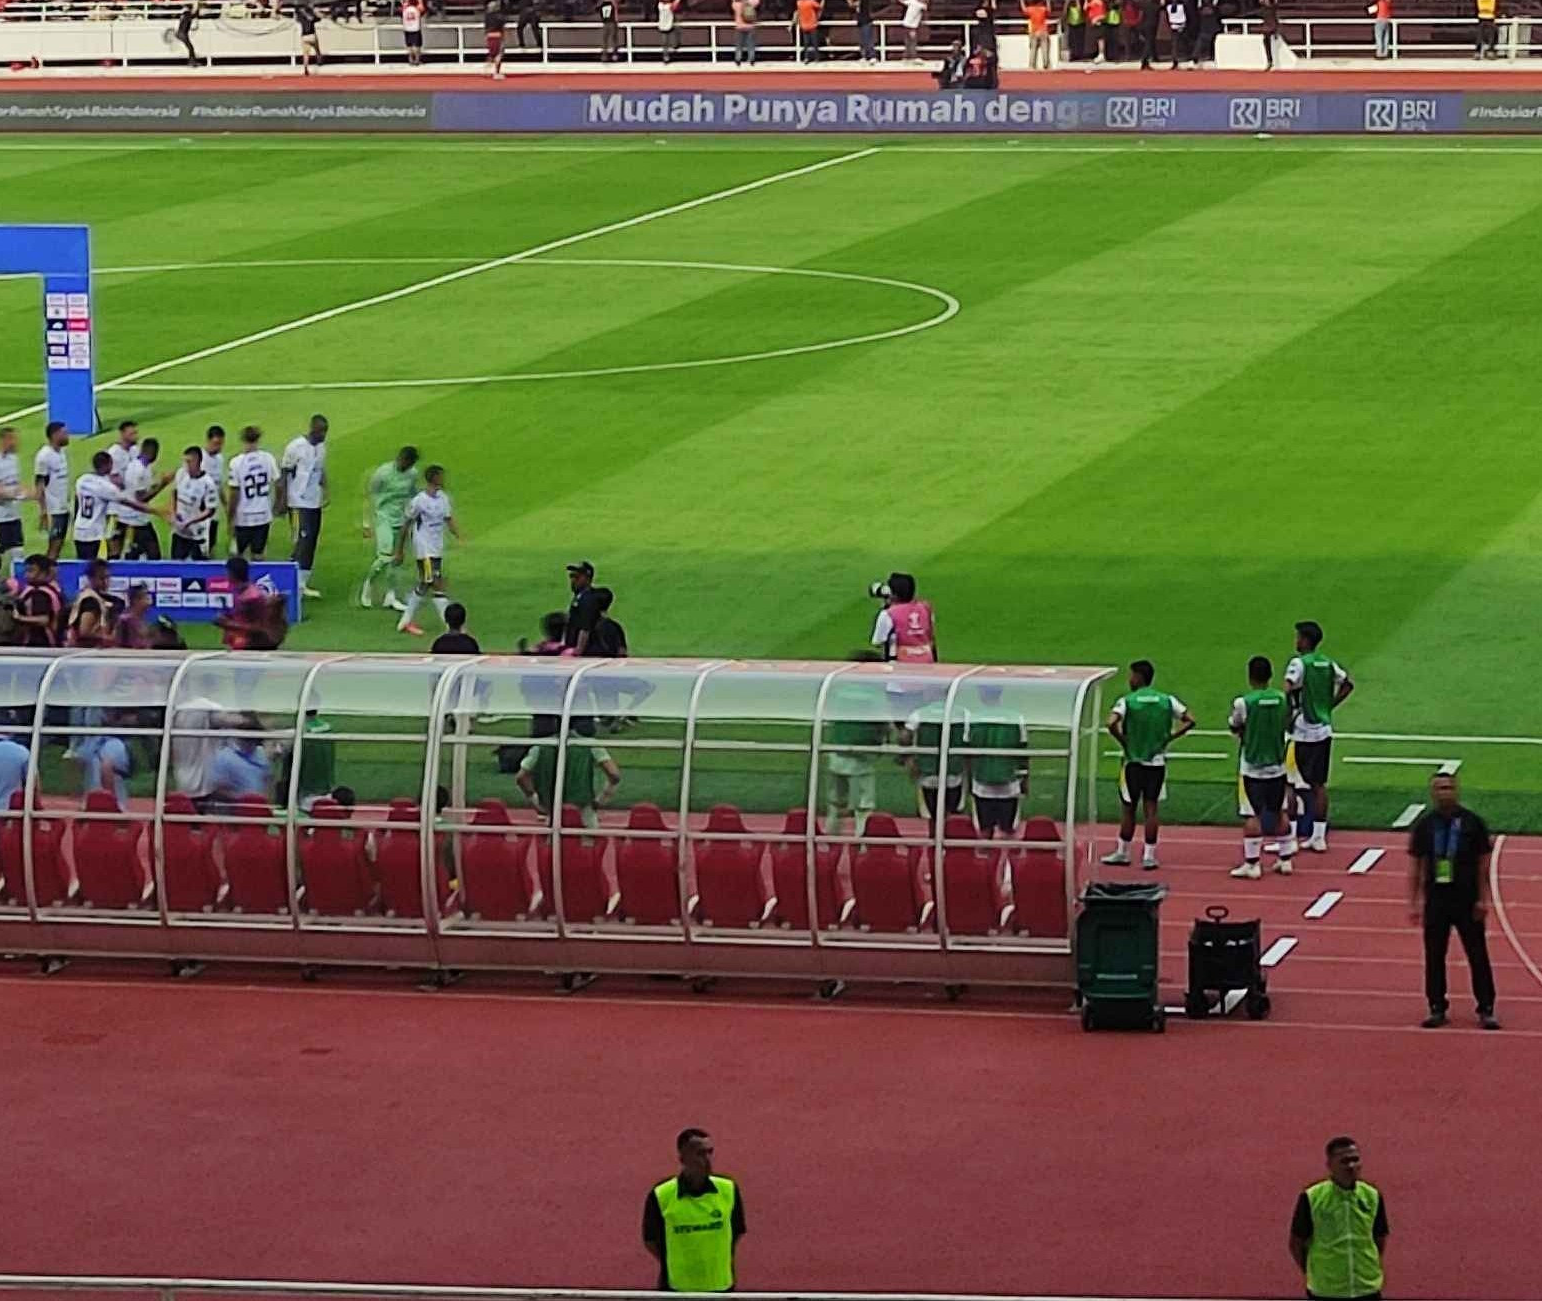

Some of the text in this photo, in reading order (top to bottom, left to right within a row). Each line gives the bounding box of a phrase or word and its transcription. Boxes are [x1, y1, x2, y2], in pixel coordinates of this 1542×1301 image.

[588, 93, 714, 123] Mudah
[724, 94, 837, 130] Punya
[846, 93, 976, 123] Rumah
[1142, 98, 1175, 117] BRI
[1266, 98, 1300, 118] BRI
[1402, 100, 1436, 120] BRI
[244, 473, 269, 498] 22
